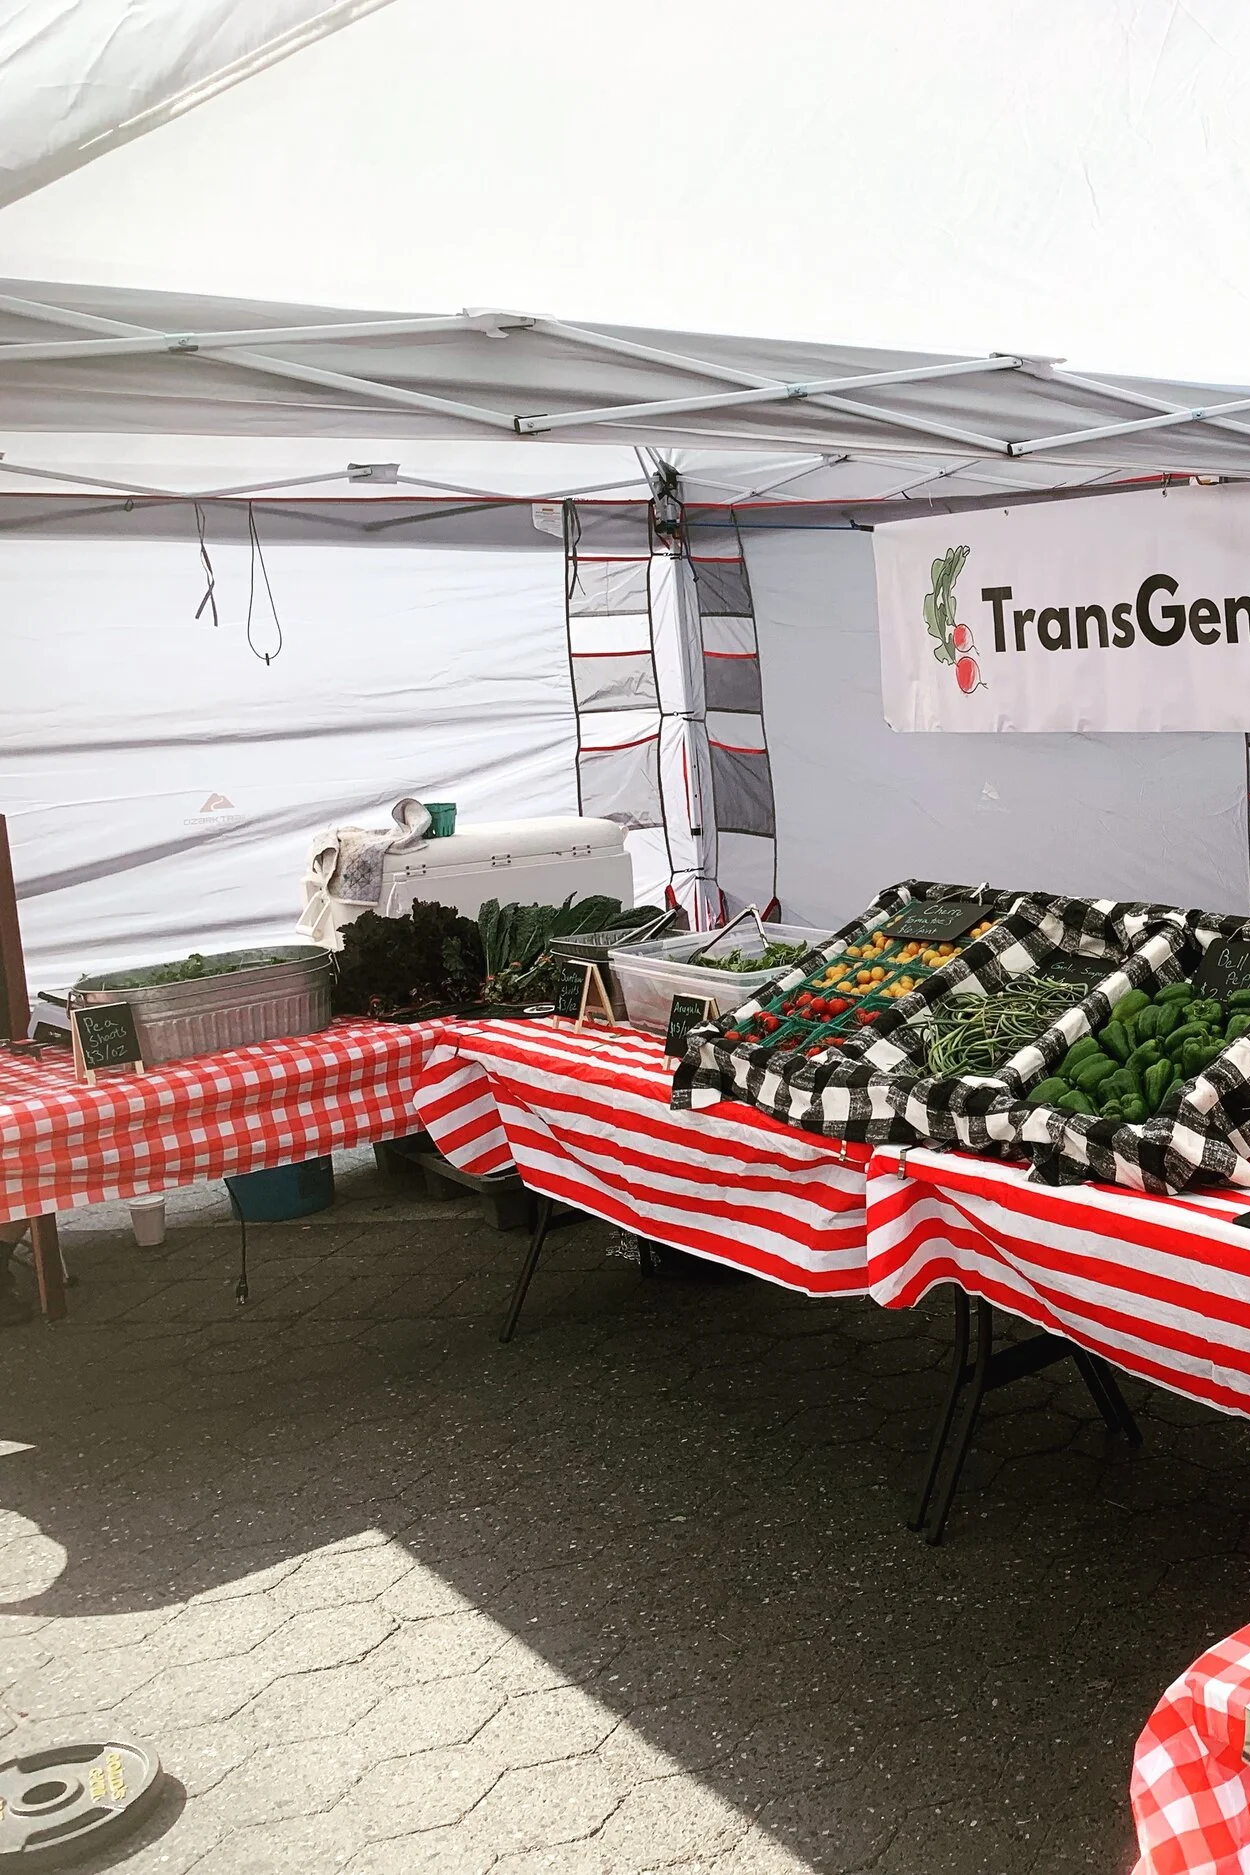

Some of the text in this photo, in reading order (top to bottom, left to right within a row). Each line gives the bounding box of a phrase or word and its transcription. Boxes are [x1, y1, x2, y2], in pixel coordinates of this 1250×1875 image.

[1218, 948, 1249, 971] Bell
[83, 1017, 119, 1034] Pea
[89, 1026, 127, 1047] Shoots
